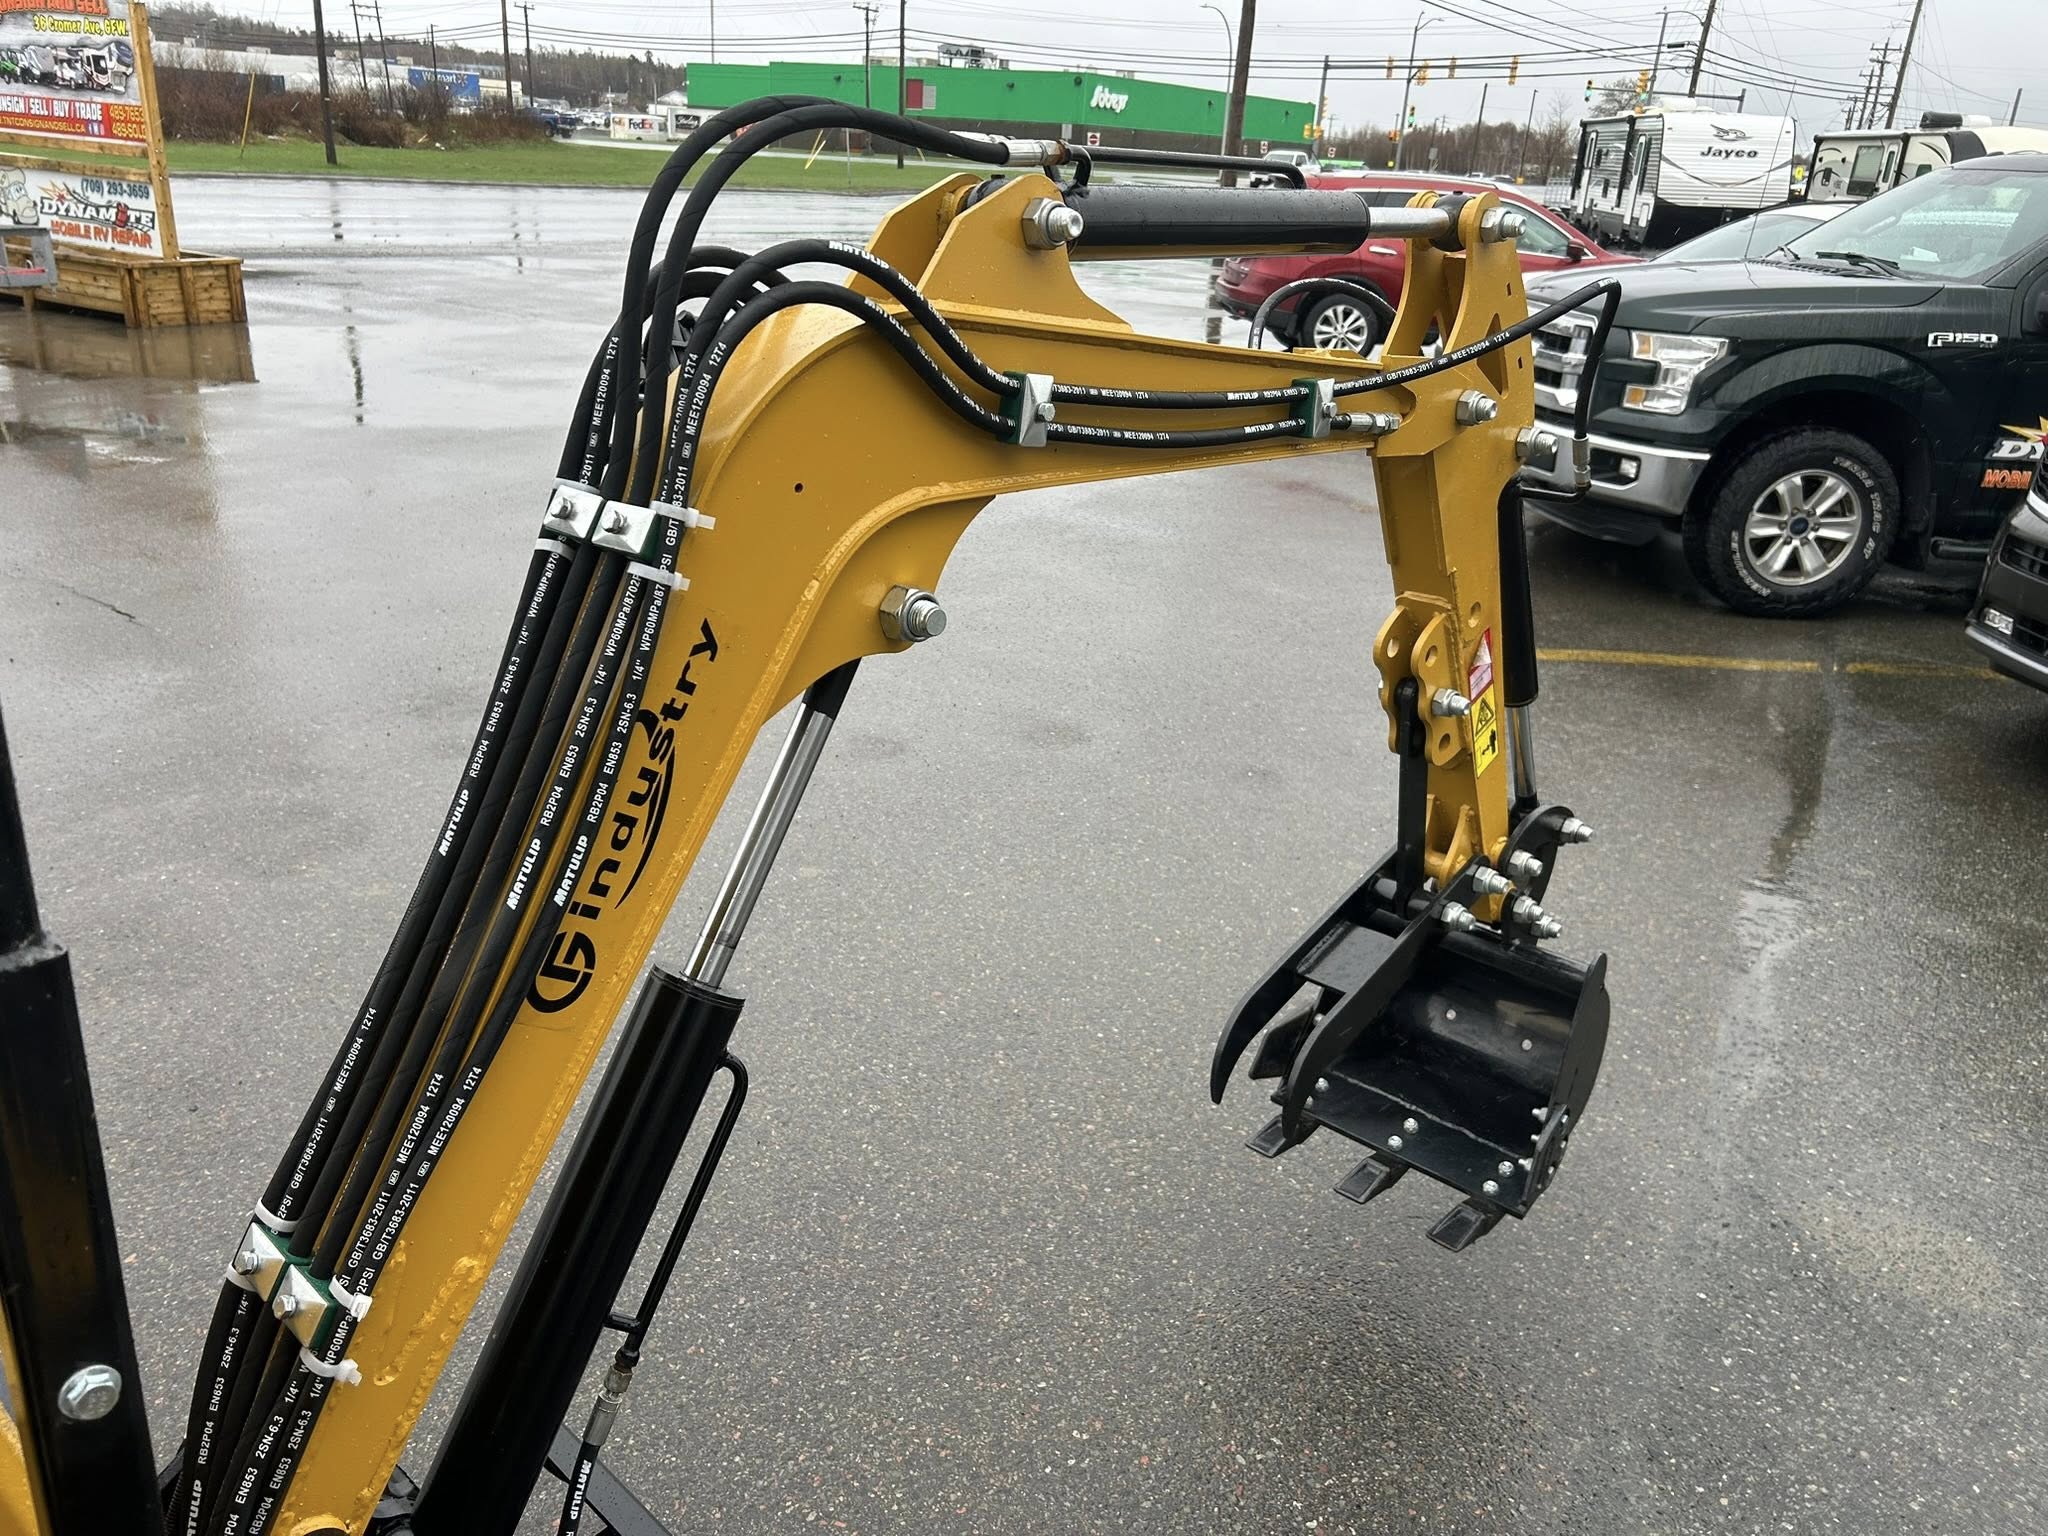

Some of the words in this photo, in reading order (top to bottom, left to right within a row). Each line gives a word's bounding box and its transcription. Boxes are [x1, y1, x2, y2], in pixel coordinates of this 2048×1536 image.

[33, 15, 47, 31] 36
[48, 16, 81, 33] Cromer
[422, 71, 457, 83] Wamart
[30, 98, 49, 115] SELL
[54, 99, 70, 118] BUY
[75, 102, 103, 121] TRADE
[1700, 146, 1759, 160] Jayco
[81, 178, 104, 197] (709)
[106, 180, 150, 200] 293-3659
[51, 220, 92, 240] MOBILE
[93, 226, 110, 241] RV
[111, 228, 153, 249] REPAIR
[829, 240, 890, 270] MATULIP
[864, 296, 911, 338] MATULIP
[683, 352, 699, 380] 12T4
[1451, 341, 1491, 361] MEE120094
[1493, 331, 1511, 345] 12T4
[592, 368, 611, 427] MEE120094
[606, 336, 619, 361] 12T4
[684, 373, 713, 436] MEE120094
[708, 341, 727, 368] 12T4
[1227, 392, 1259, 401] MATULIP
[1243, 424, 1275, 434] MATULIP
[438, 789, 470, 857] MATULIP
[469, 739, 490, 779] RB2P04
[486, 701, 504, 733] EN853
[500, 656, 521, 695] 2SN-6.3
[518, 625, 529, 646] 1/4"
[506, 838, 542, 910] MATULIP
[540, 785, 565, 827] RB2P04
[559, 744, 580, 779] EN853
[574, 696, 598, 738] 2SN-6.3
[594, 664, 607, 686] 1/4"
[553, 835, 589, 907] MATULIP
[586, 782, 610, 824] RB2P04
[603, 741, 623, 776] EN853
[616, 692, 638, 735] 2SN-6.3
[631, 659, 644, 682] 1/4"
[290, 1116, 329, 1190] GB/T3683-2011
[333, 1036, 365, 1093] MEE120094
[360, 1007, 378, 1032] 12T4
[347, 1190, 391, 1269] GB/T3683-2011
[396, 1104, 431, 1165] MEE120094
[426, 1072, 445, 1098] 12T4
[372, 1183, 420, 1261] GB/T3683-2011
[427, 1097, 466, 1157] MEE120094
[463, 1066, 483, 1093] 12T4
[197, 1421, 215, 1465] RB2P04
[209, 1376, 225, 1413] EN853
[220, 1327, 240, 1369] 2SN-6.3
[237, 1292, 248, 1316] 1/4"
[235, 1467, 258, 1504] EN853
[255, 1415, 285, 1460] 2SN-6.3
[284, 1380, 298, 1404] 1/4"
[248, 1496, 275, 1535] RB2P04
[269, 1457, 292, 1490] EN853
[287, 1410, 312, 1451] 2SN-6.3
[309, 1376, 324, 1398] 1/4"
[570, 1459, 593, 1520] MATULIP
